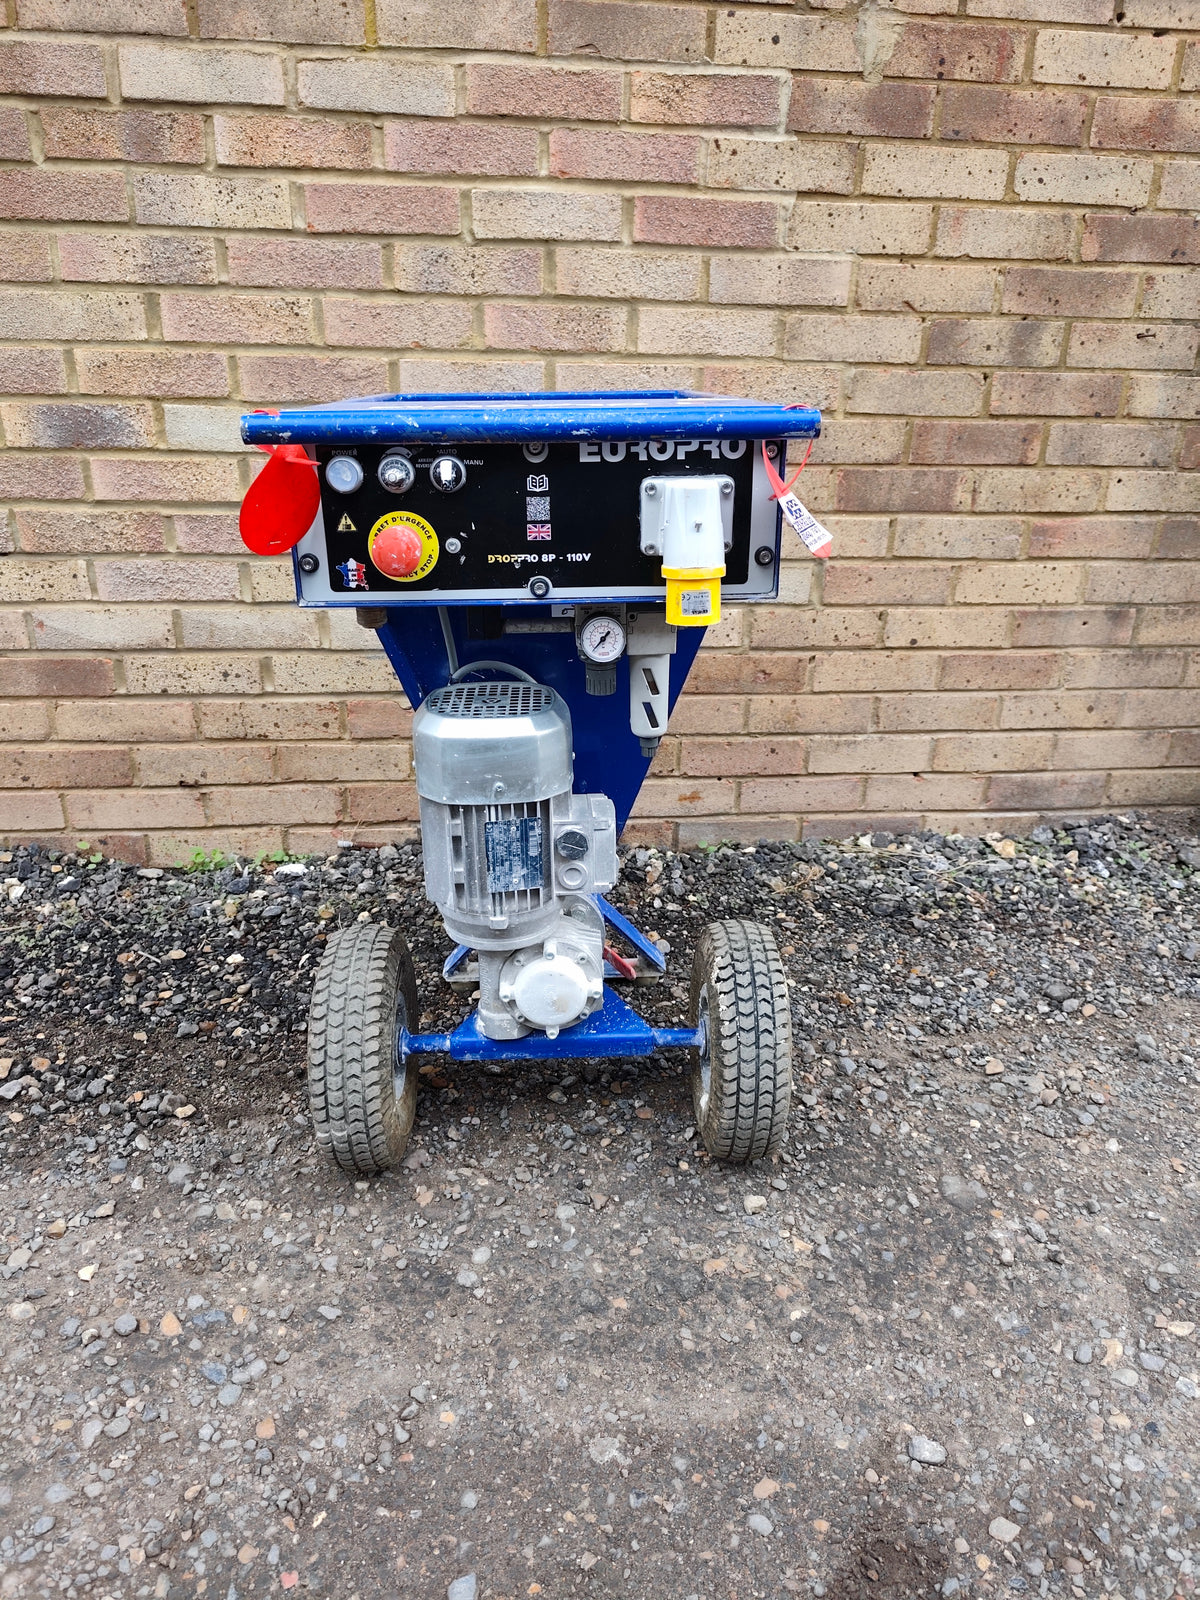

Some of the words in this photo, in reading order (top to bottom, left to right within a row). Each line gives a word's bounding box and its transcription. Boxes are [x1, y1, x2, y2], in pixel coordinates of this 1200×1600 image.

[579, 440, 747, 462] EUROPRO
[392, 515, 433, 541] D'URGENCE
[420, 553, 434, 573] STOP
[487, 554, 539, 563] DROPPRO
[541, 553, 556, 562] 8P
[566, 553, 592, 562] 110V
